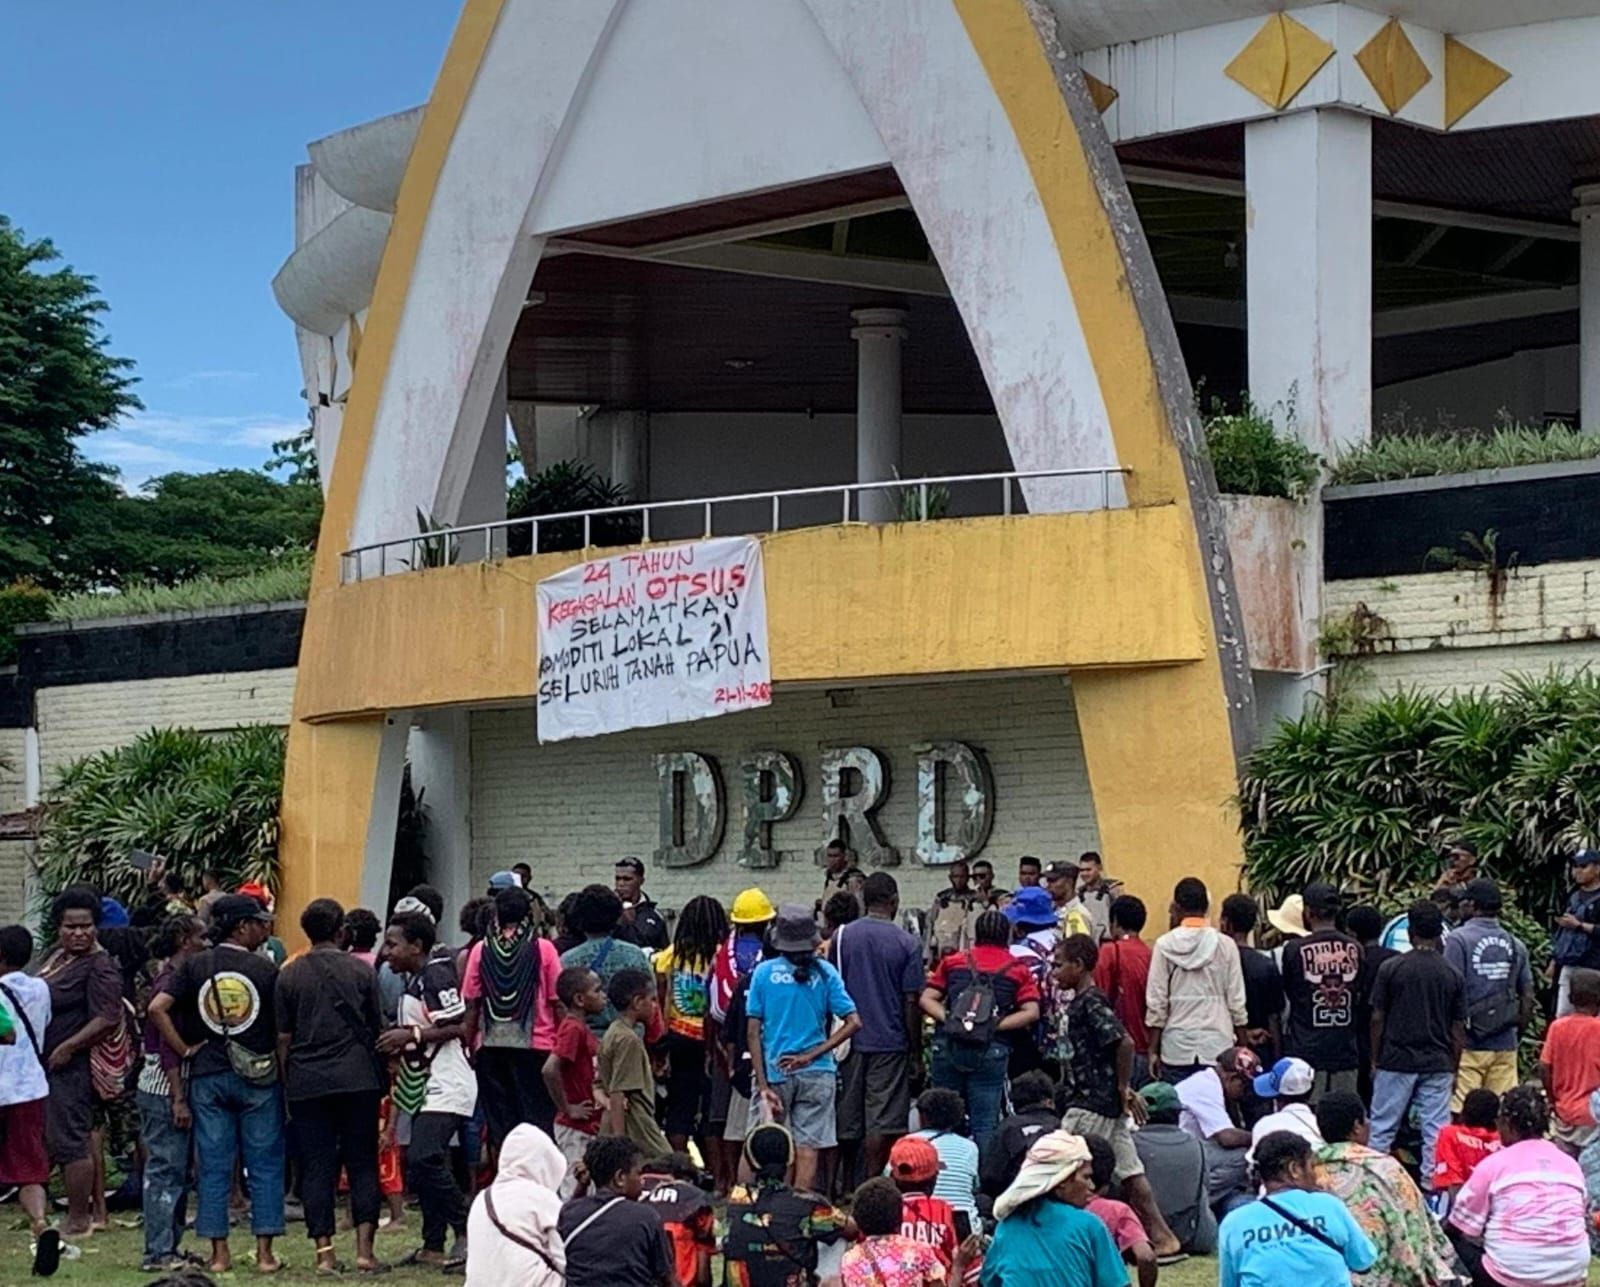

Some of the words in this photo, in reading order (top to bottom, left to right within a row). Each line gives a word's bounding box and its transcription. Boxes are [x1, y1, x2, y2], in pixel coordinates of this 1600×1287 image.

[547, 583, 636, 630] KEGAGALAN
[646, 564, 746, 601] OTSUS
[583, 562, 611, 585] 24
[621, 545, 694, 578] TAHUN
[539, 664, 620, 705] SELURUH
[624, 652, 675, 685] TANAH
[686, 632, 762, 677] PAPUA
[612, 622, 693, 657] LOKAL
[652, 740, 994, 868] DPRD
